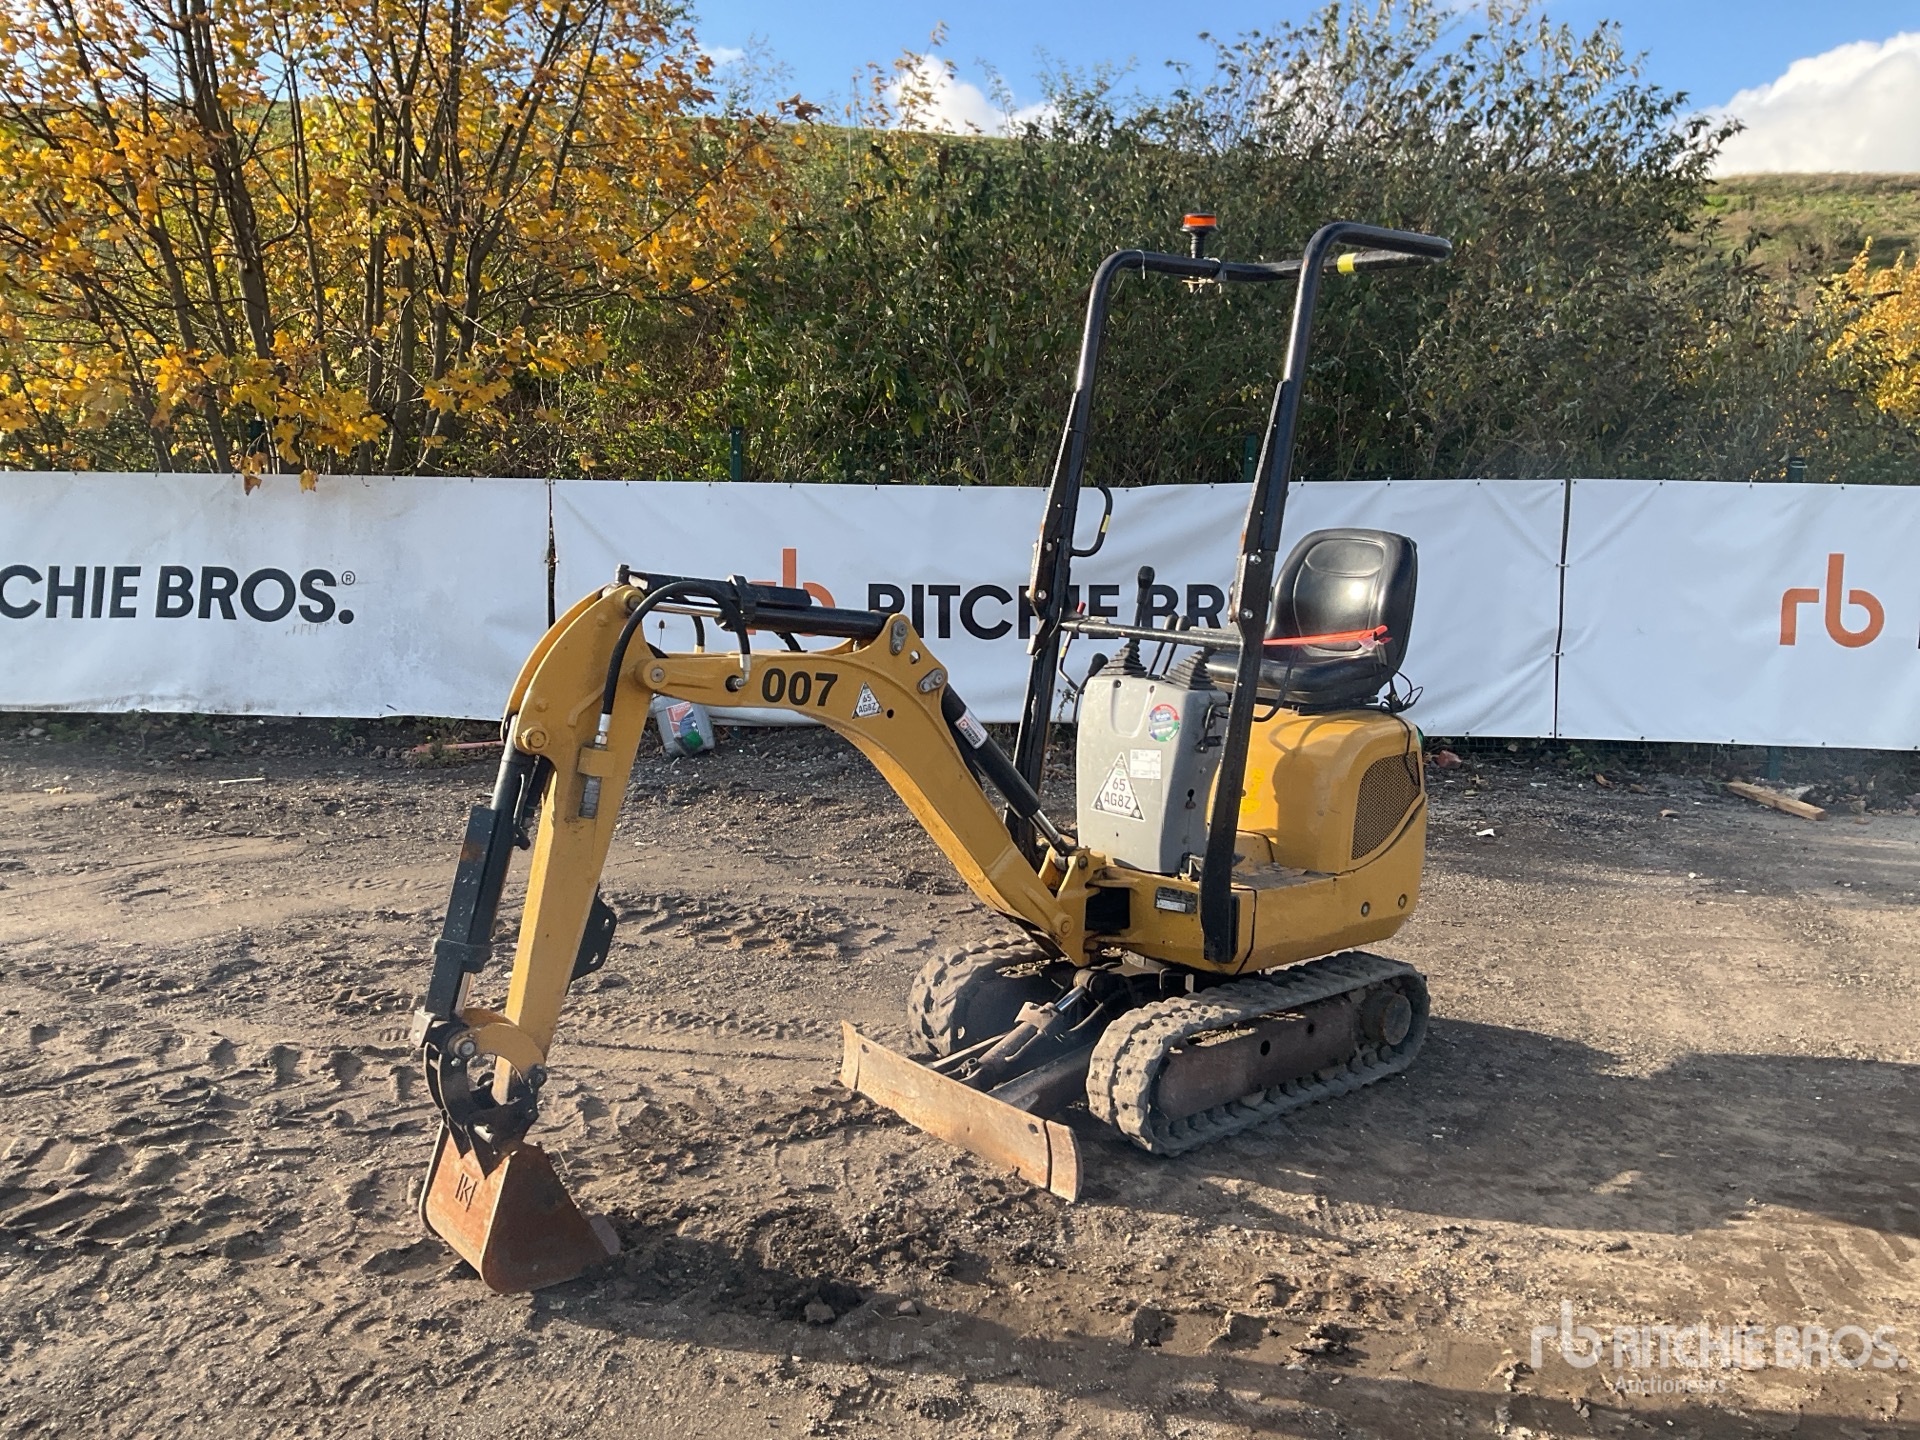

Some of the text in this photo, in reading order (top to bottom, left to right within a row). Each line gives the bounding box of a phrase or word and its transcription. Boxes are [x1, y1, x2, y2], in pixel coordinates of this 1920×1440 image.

[1780, 553, 1885, 648] rb
[762, 668, 838, 707] 007
[863, 693, 872, 703] 65
[1112, 777, 1126, 792] 65
[1104, 791, 1131, 810] AG8Z
